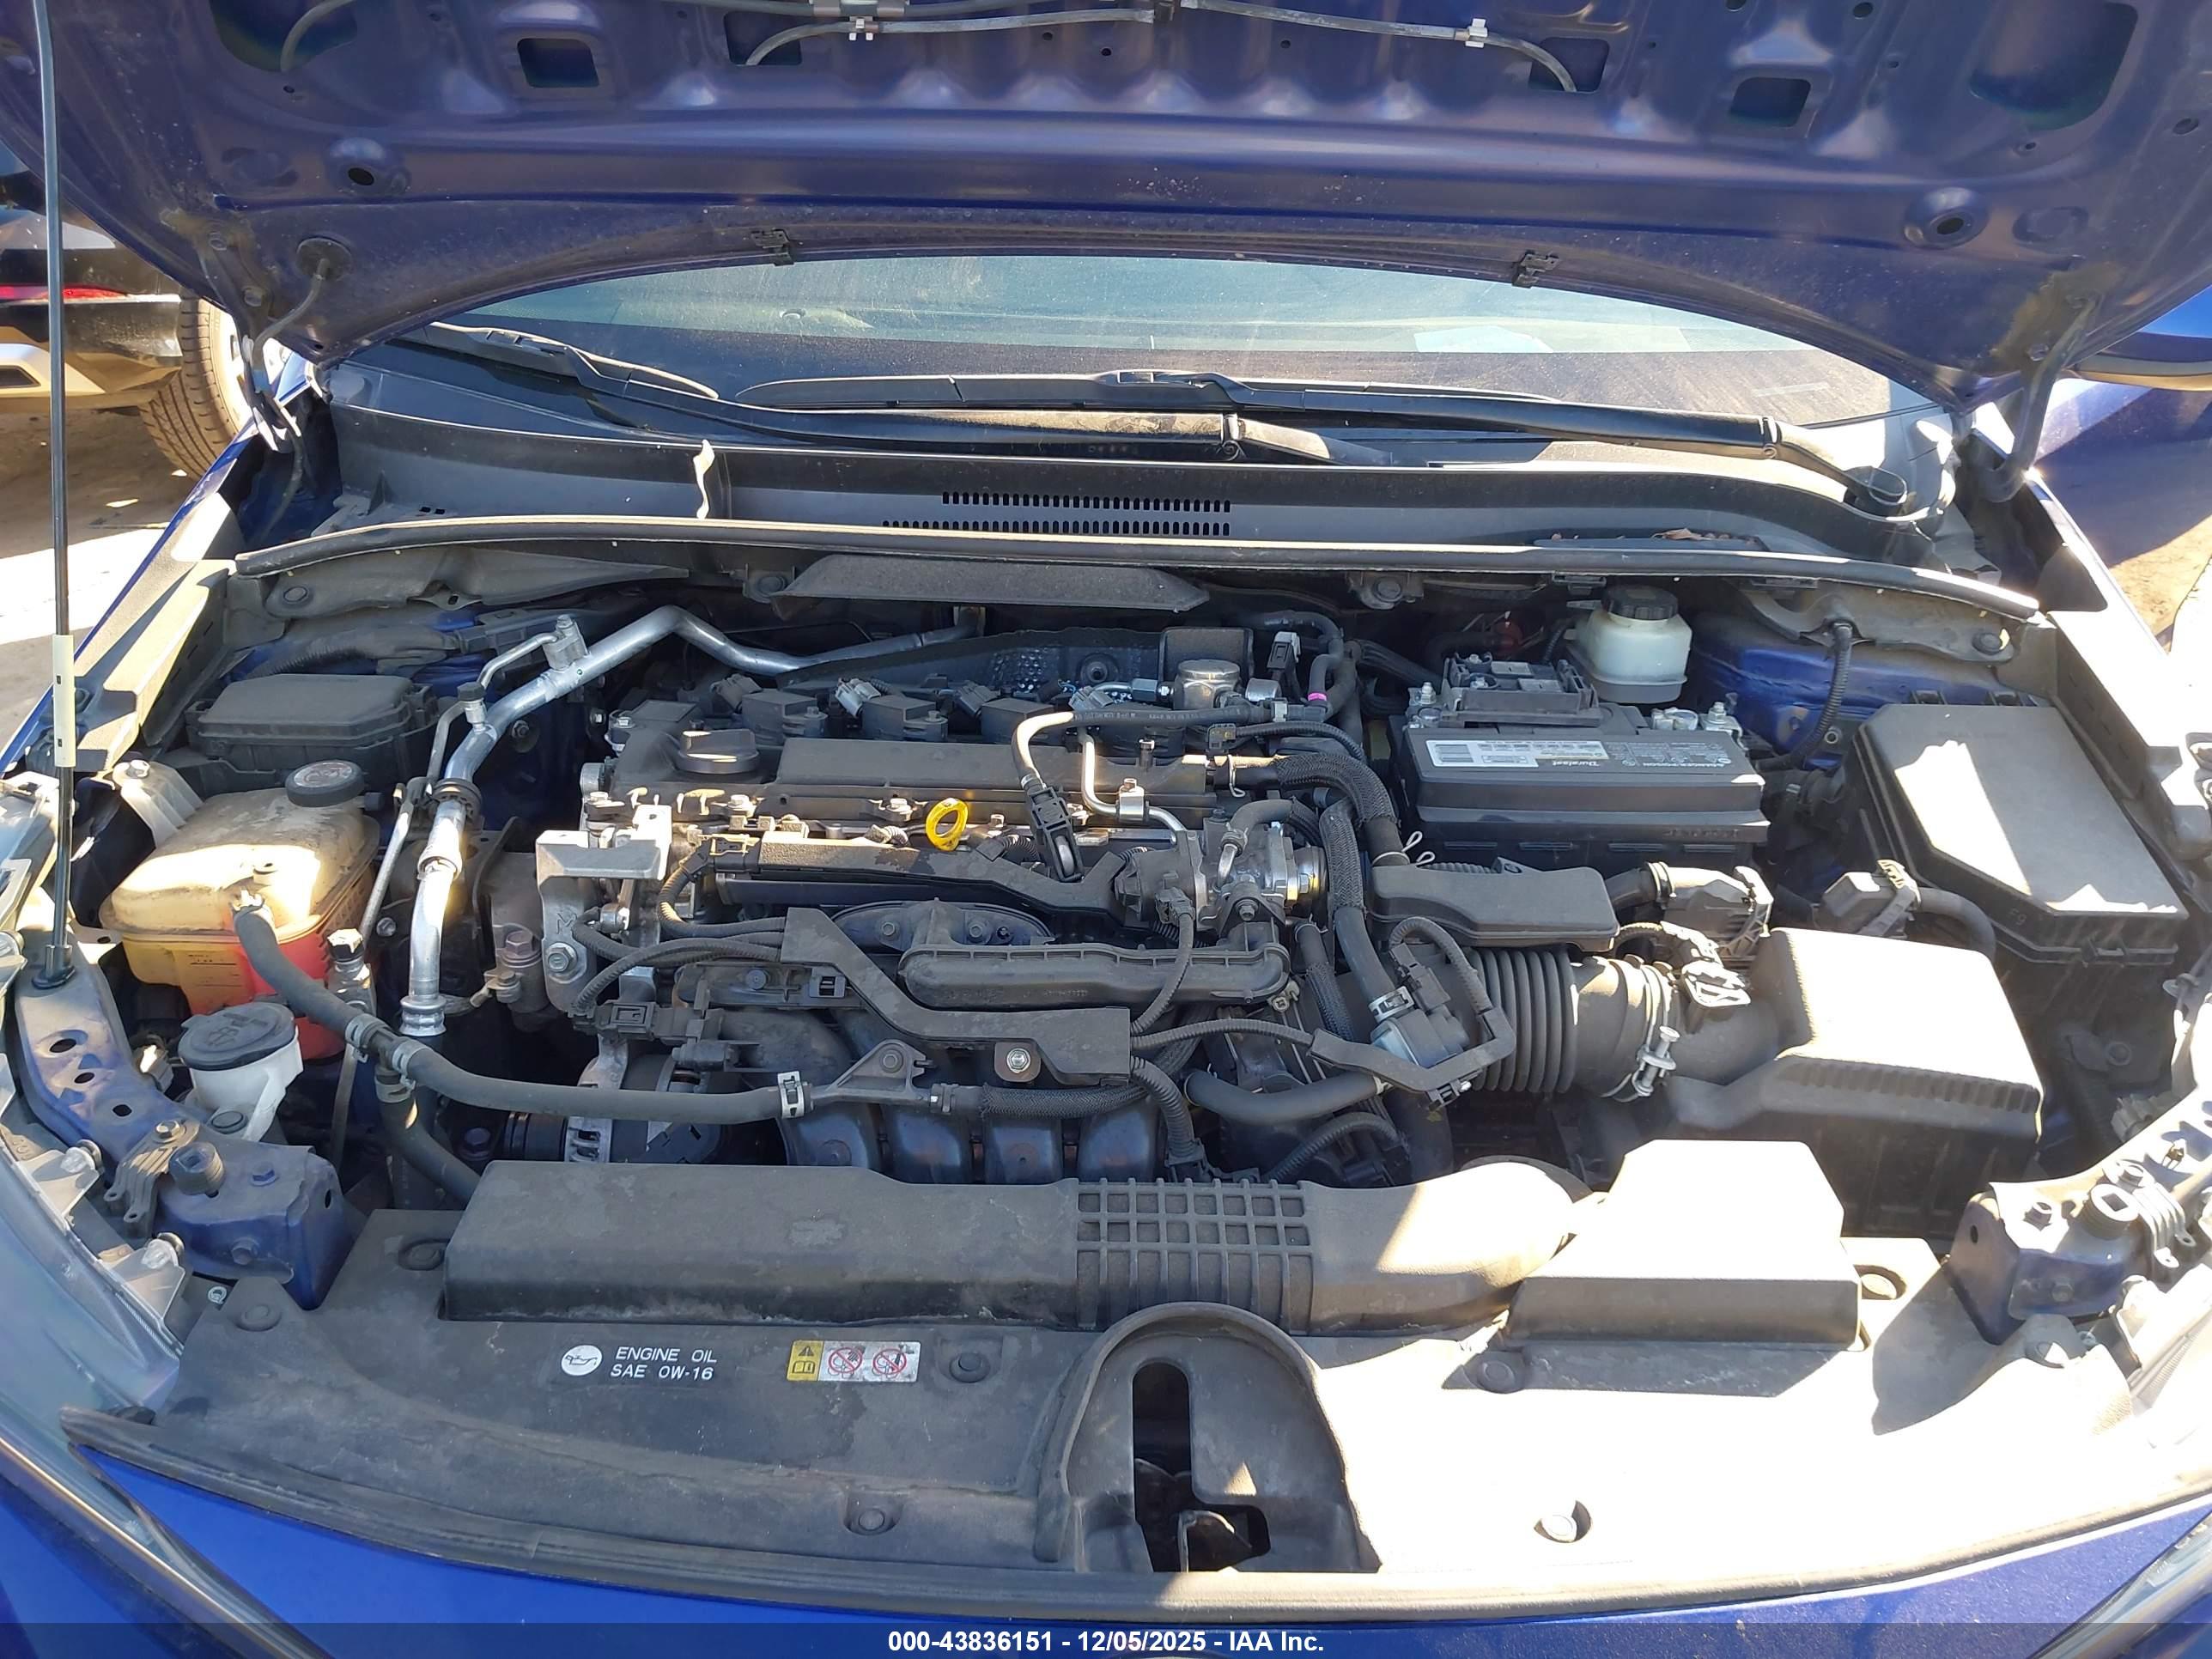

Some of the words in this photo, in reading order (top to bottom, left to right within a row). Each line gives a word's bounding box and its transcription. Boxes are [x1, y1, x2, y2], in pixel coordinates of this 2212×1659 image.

[615, 1346, 681, 1362] ENGINE
[690, 1348, 718, 1364] OIL
[610, 1363, 647, 1378] SAE
[658, 1364, 714, 1381] 0W-16
